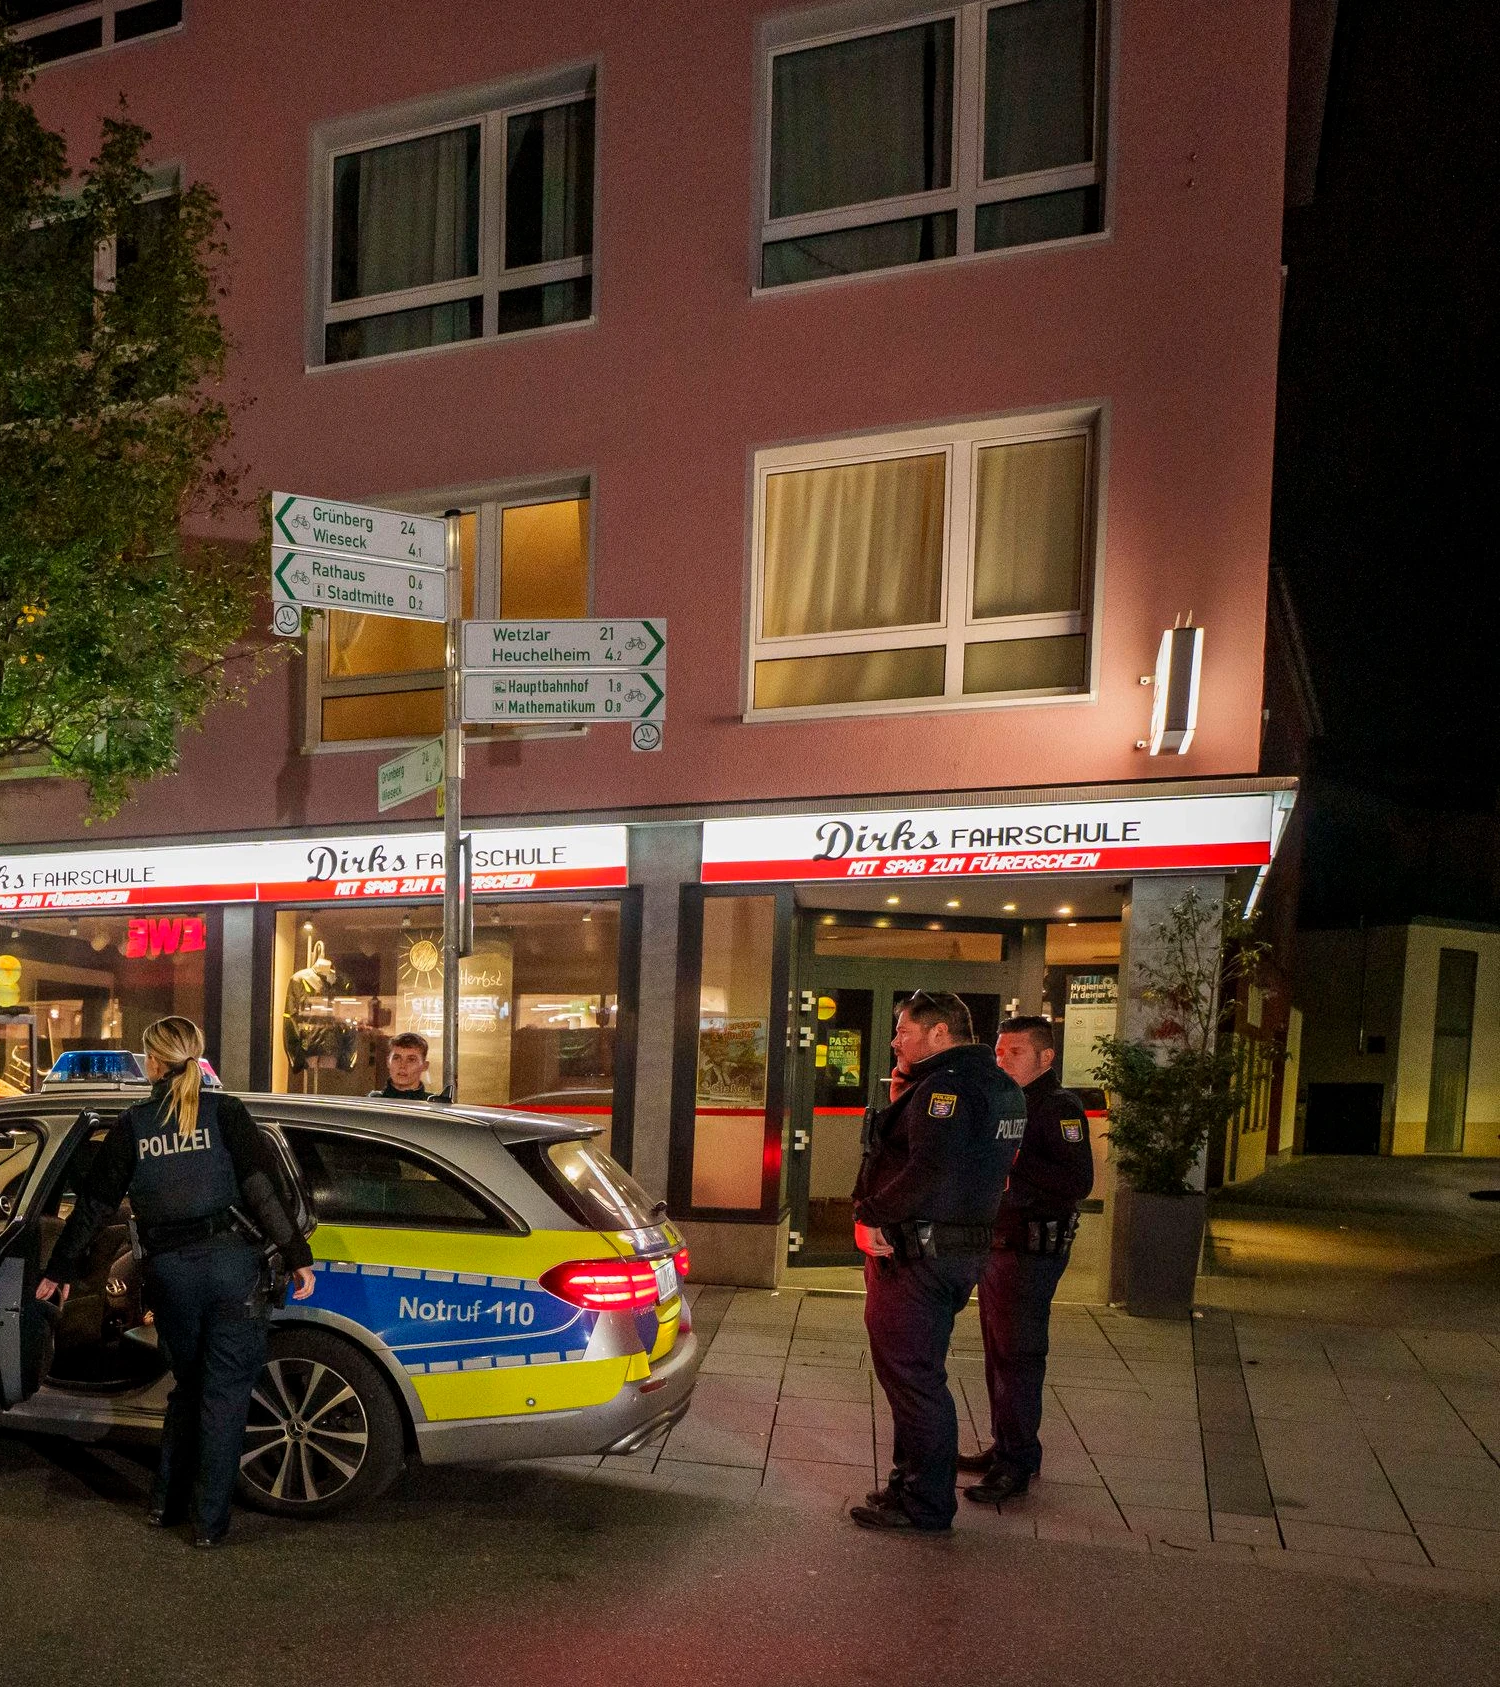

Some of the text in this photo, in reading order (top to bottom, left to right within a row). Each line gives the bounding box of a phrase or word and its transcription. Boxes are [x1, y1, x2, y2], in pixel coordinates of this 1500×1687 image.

[313, 506, 416, 536] Grünberg 24
[313, 527, 422, 558] Wieseck 4.1
[312, 562, 423, 590] Rathaus 0.6
[327, 585, 394, 607] Stadtmitte
[408, 595, 423, 611] 0.2
[493, 627, 614, 642] Wetzlar 21
[492, 648, 622, 662] Heuchelheim 4.2
[509, 678, 622, 696] Hauptbahnhof 1.8
[509, 700, 595, 714] Mathematikum
[605, 700, 621, 713] 0.8
[812, 819, 1141, 861] Dirks FAHRSCHULE
[307, 844, 567, 882] Dirks FASCHULE
[847, 861, 878, 875] MIT
[929, 856, 966, 873] ZUM
[968, 852, 1101, 871] FÜHRERSCHEIN
[32, 866, 155, 887] FAHRSCHULE
[334, 881, 358, 896] MIT
[400, 878, 430, 892] ZUM
[19, 894, 44, 908] ZUM
[458, 968, 503, 988] Herbst
[1080, 991, 1106, 999] deiner
[829, 1037, 859, 1046] PASST
[138, 1128, 211, 1159] POLIZEI
[399, 1296, 535, 1326] Notruf 110
